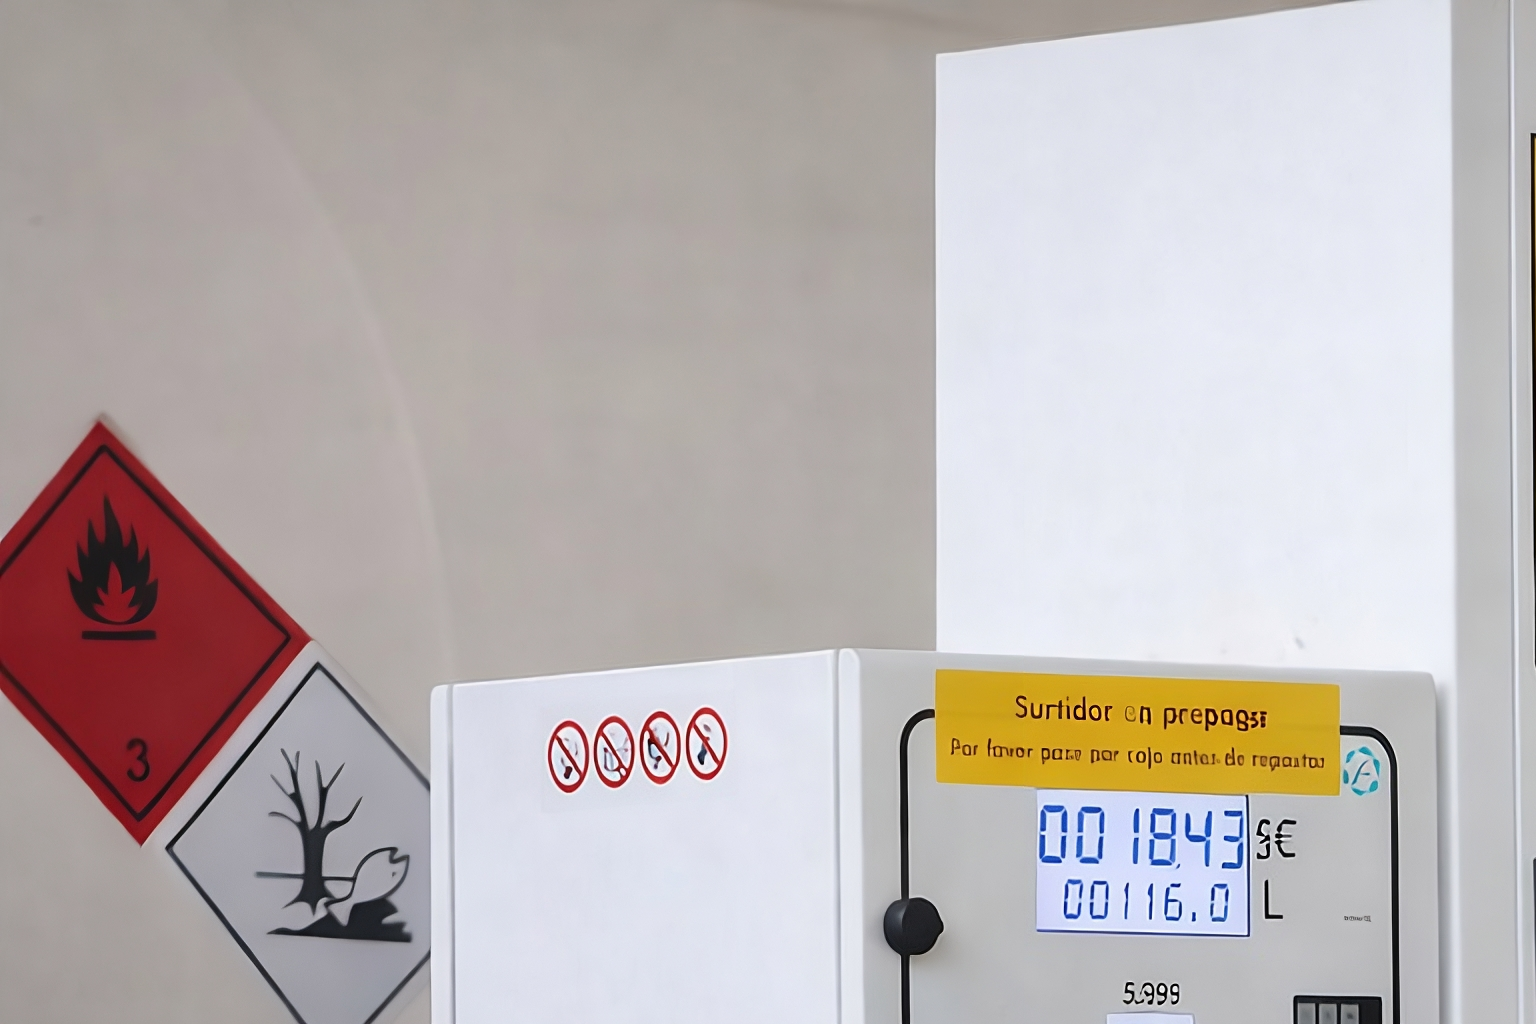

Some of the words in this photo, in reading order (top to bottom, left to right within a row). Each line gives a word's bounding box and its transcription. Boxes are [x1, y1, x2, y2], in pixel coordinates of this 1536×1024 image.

[1014, 695, 1114, 722] Surtidor
[126, 737, 151, 783] 3
[1263, 879, 1284, 920] L
